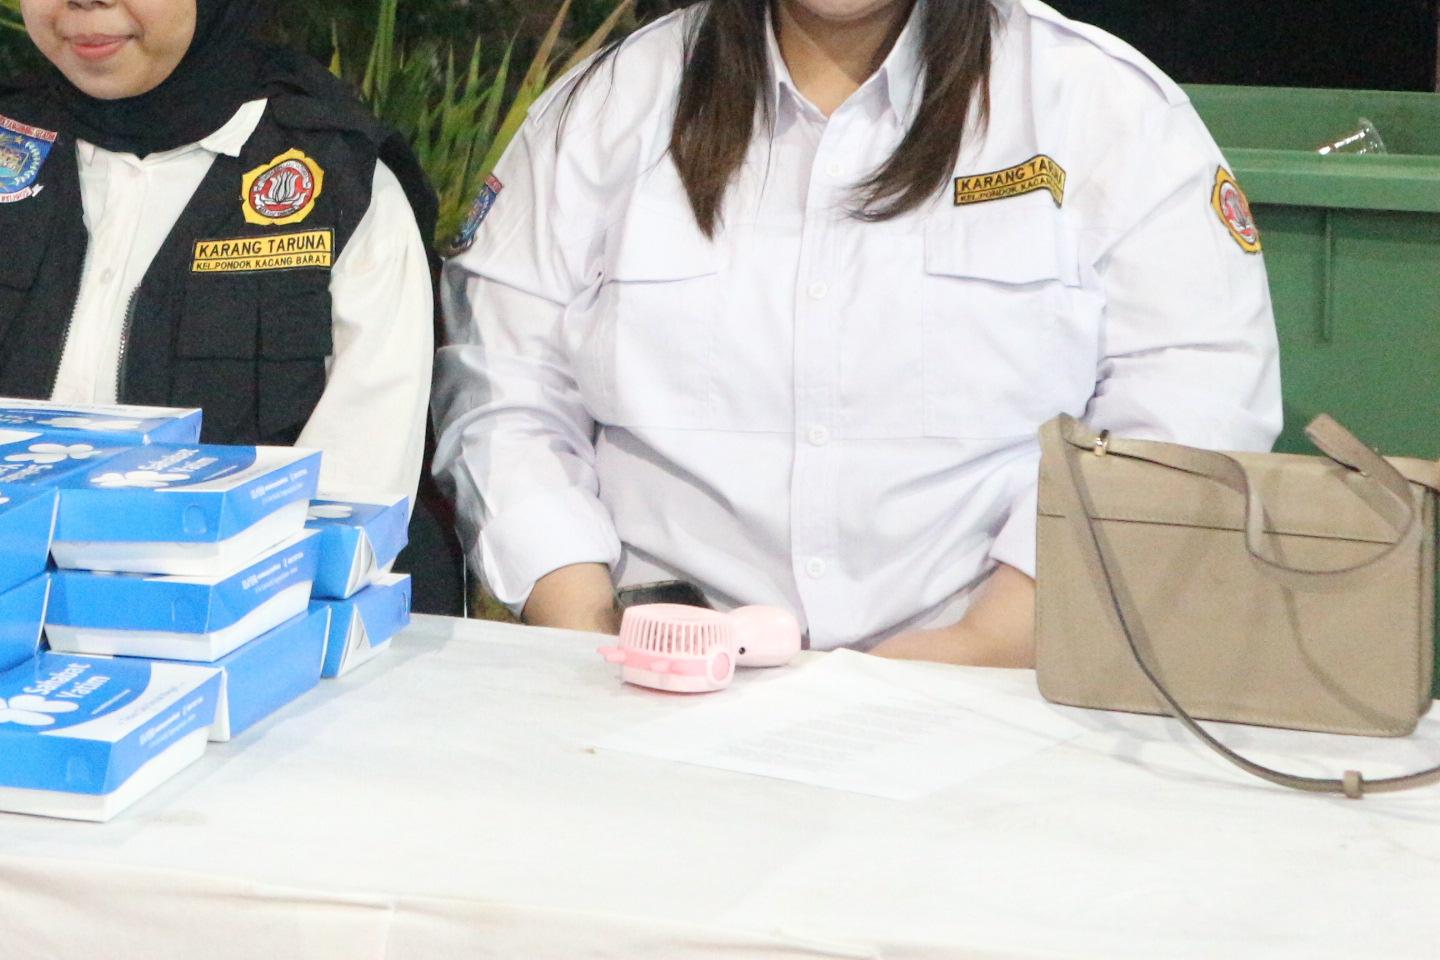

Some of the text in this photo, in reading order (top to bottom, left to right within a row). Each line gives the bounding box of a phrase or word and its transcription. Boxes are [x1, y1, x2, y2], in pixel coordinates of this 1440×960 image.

[961, 167, 1025, 191] KARANG
[199, 233, 326, 258] KARANG TARUNA
[255, 256, 294, 269] KACANG
[295, 254, 327, 266] BARAT
[22, 662, 92, 696] Sahabat
[55, 675, 111, 699] Yatim
